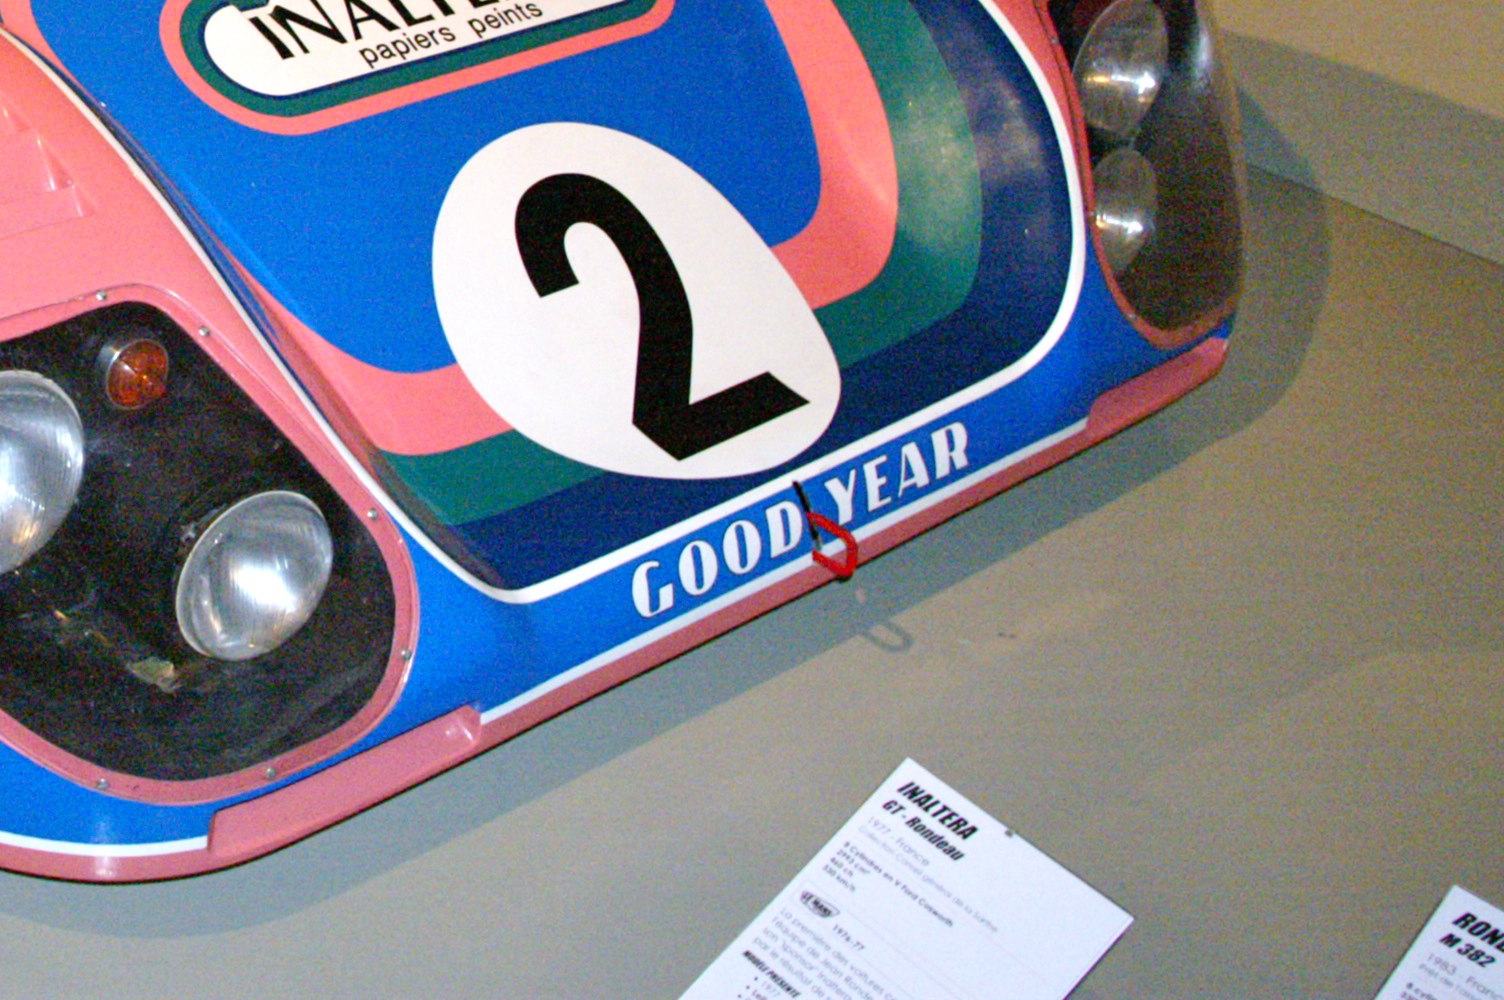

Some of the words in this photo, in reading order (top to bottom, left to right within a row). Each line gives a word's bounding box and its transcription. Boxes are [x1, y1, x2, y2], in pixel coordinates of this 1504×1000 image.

[358, 23, 458, 70] papiers
[468, 0, 544, 40] peints
[515, 172, 811, 462] 2
[882, 799, 905, 814] GT
[906, 817, 963, 860] Rondeau
[898, 782, 977, 839] INALTERA
[895, 837, 929, 866] France
[901, 884, 918, 900] Ford
[918, 898, 952, 926] Cosworth
[1440, 933, 1461, 947] M
[1457, 943, 1495, 967] 382
